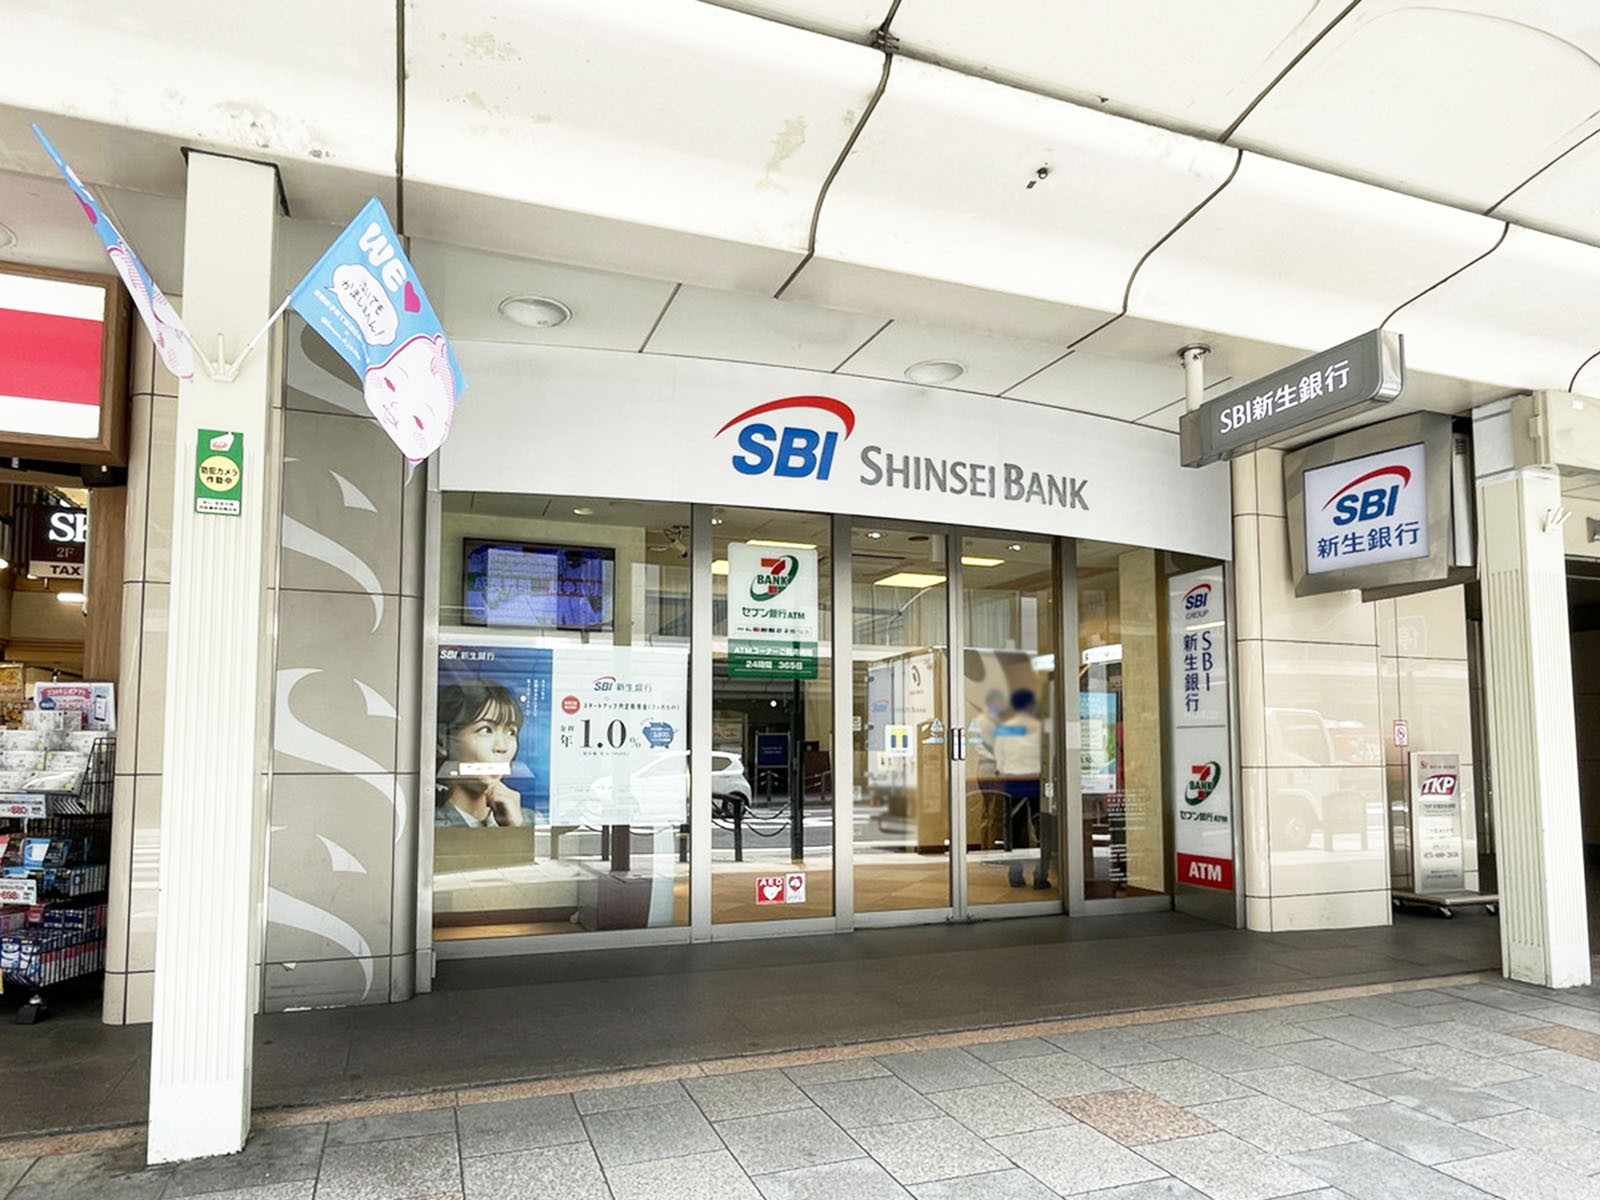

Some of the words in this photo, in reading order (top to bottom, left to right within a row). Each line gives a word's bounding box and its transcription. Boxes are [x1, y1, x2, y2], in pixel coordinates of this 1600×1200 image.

[358, 222, 407, 293] WE
[1220, 360, 1350, 433] SBI新生銀行
[732, 423, 839, 481] SBI
[860, 445, 996, 499] SHINSEI
[1003, 462, 1090, 511] BANK
[1333, 484, 1399, 526] SBI
[1317, 521, 1420, 559] 新生銀行
[50, 565, 81, 576] TAX
[757, 574, 788, 586] BANK
[1185, 592, 1208, 610] SBI
[594, 681, 613, 691] SBI
[1183, 633, 1200, 713] 新生銀行
[1423, 776, 1455, 794] TKP
[1188, 861, 1223, 882] ATM
